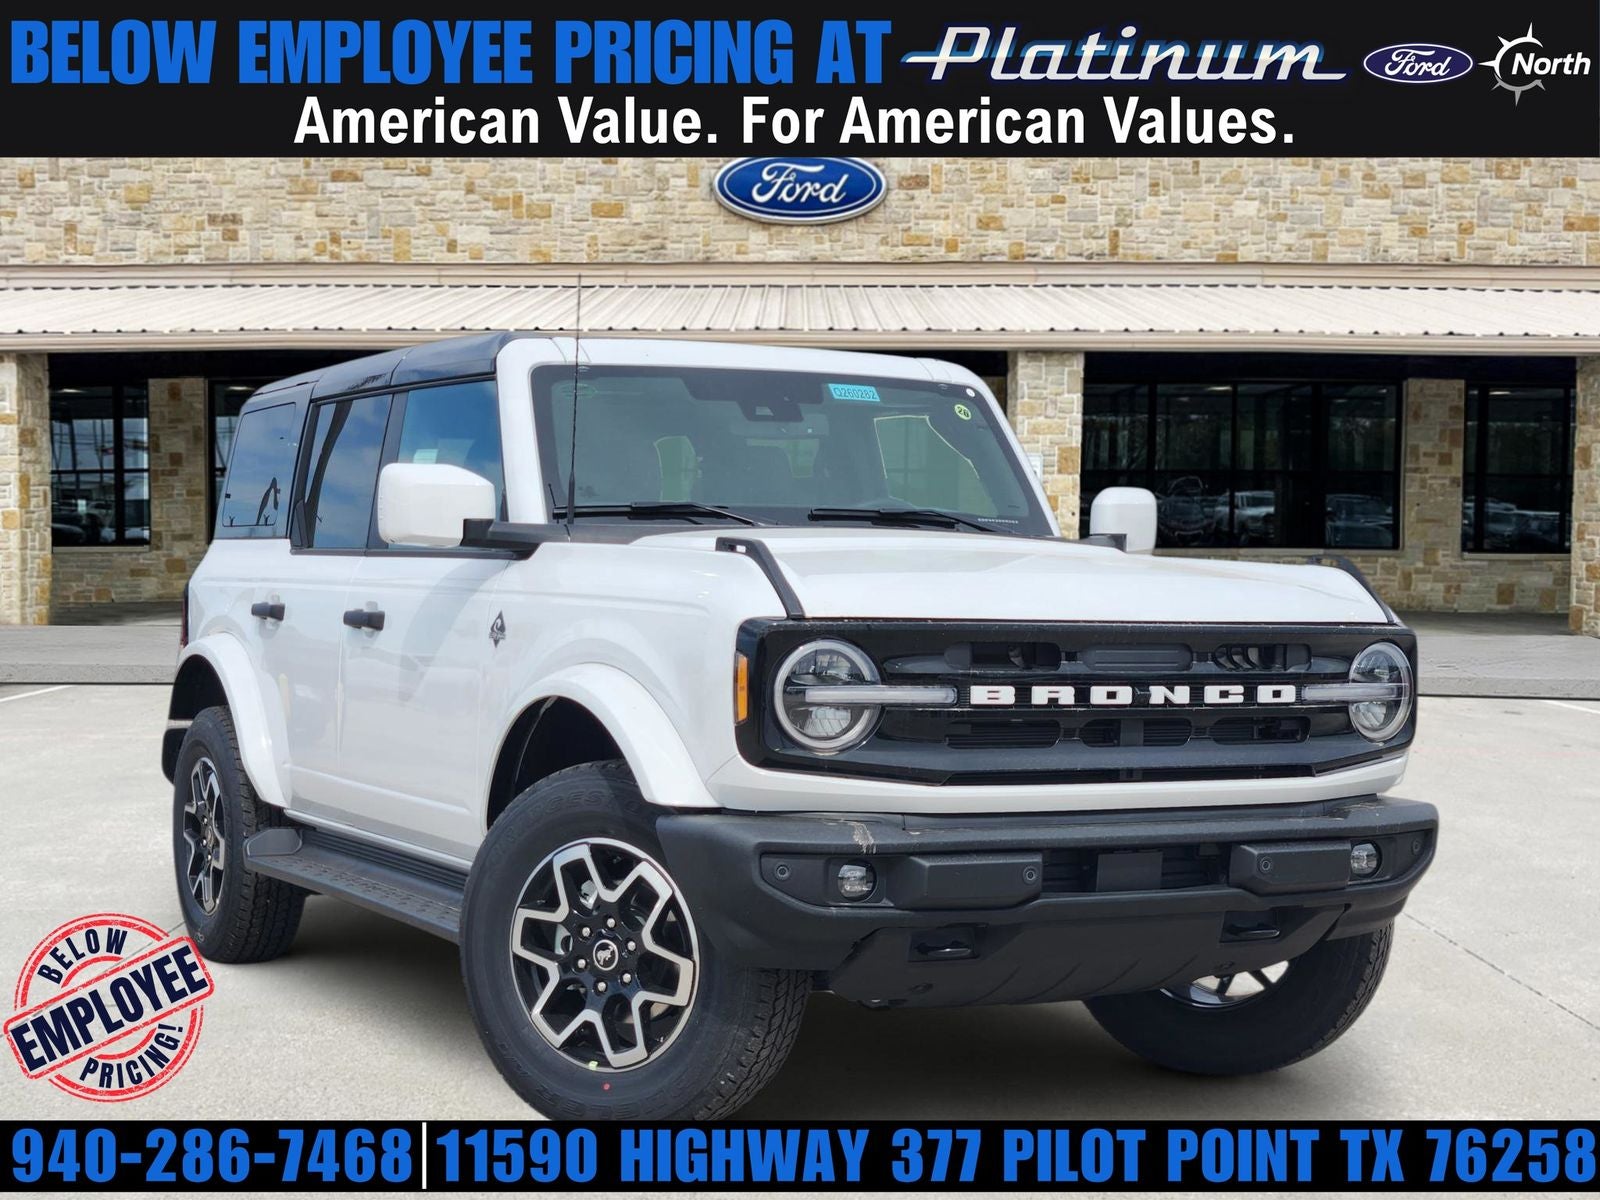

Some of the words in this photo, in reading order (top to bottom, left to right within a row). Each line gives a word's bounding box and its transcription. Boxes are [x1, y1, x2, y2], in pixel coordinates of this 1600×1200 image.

[752, 163, 848, 203] Ford
[833, 387, 878, 400] Q260282
[970, 685, 1297, 705] BRONCO
